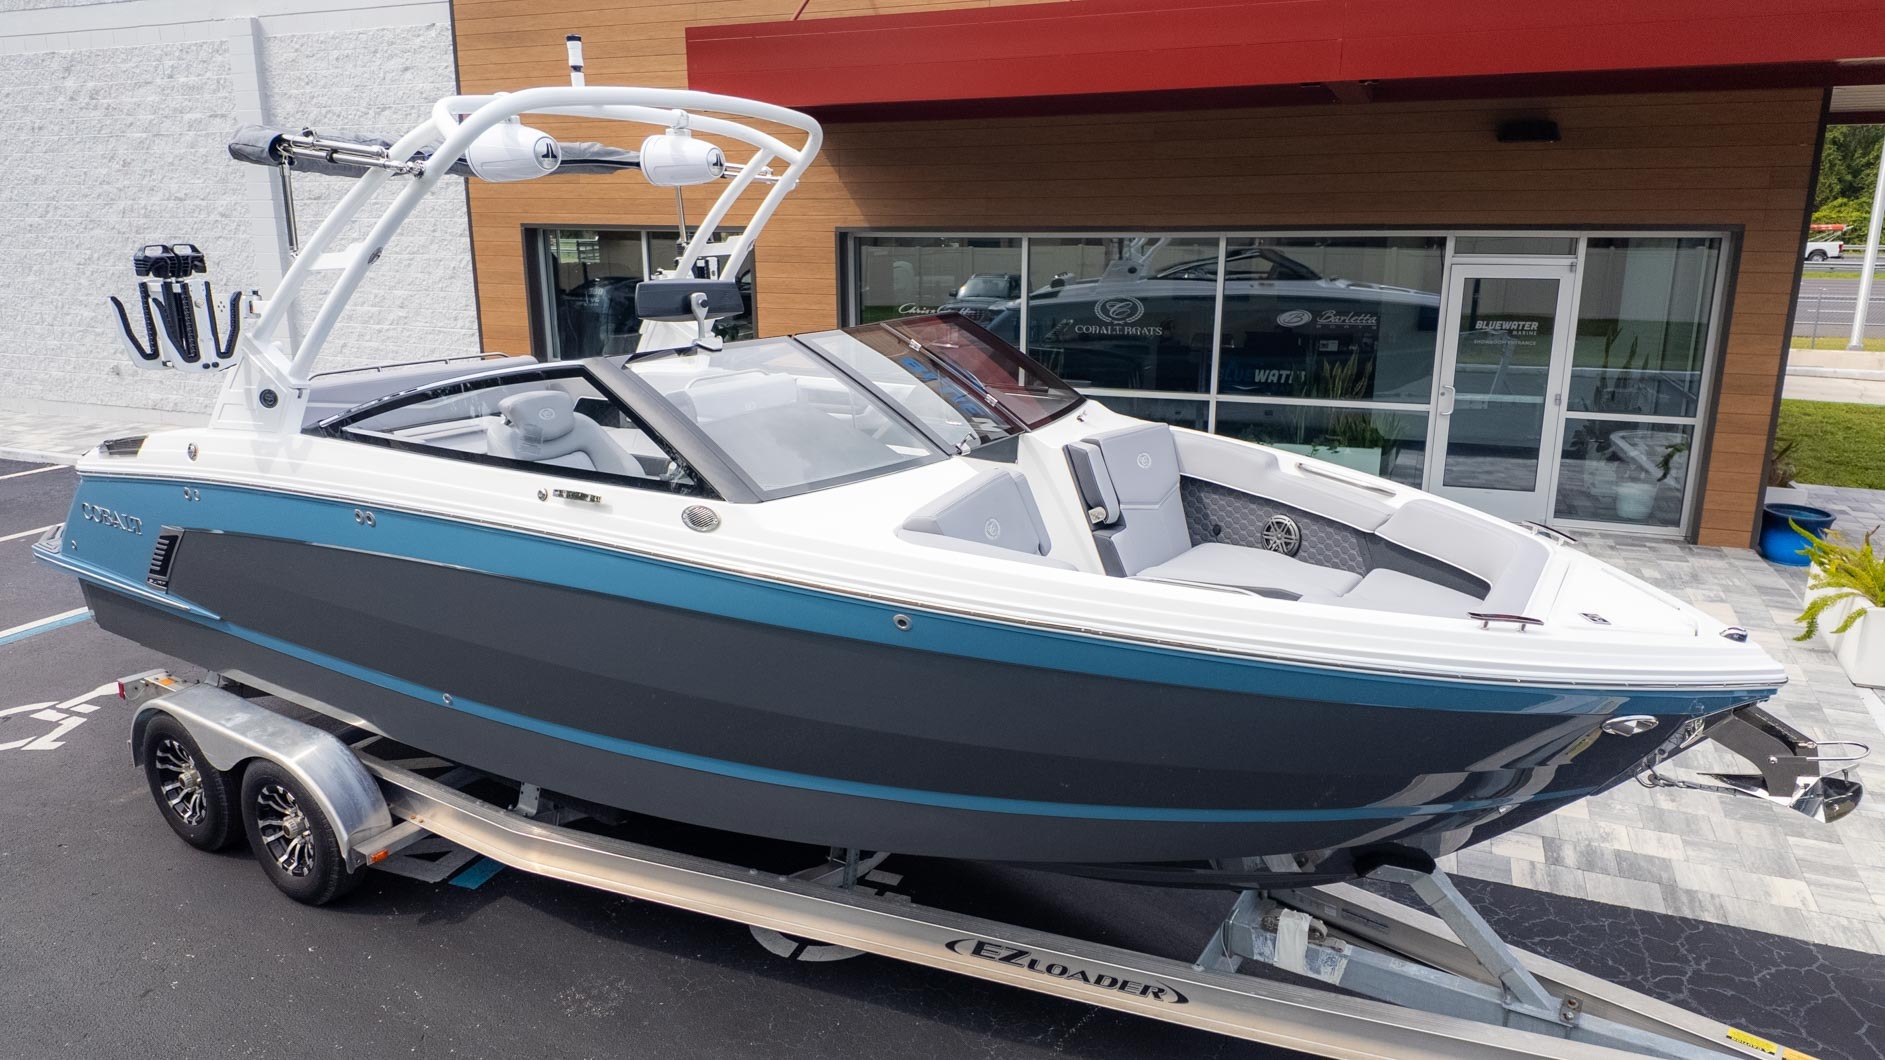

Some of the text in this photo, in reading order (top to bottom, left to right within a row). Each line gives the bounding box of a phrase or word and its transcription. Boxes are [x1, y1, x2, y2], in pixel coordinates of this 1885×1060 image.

[1316, 310, 1377, 324] Barletta
[1075, 325, 1163, 335] COBALT BOATS
[1475, 320, 1539, 330] BLUEWATER
[82, 502, 143, 536] COBALT
